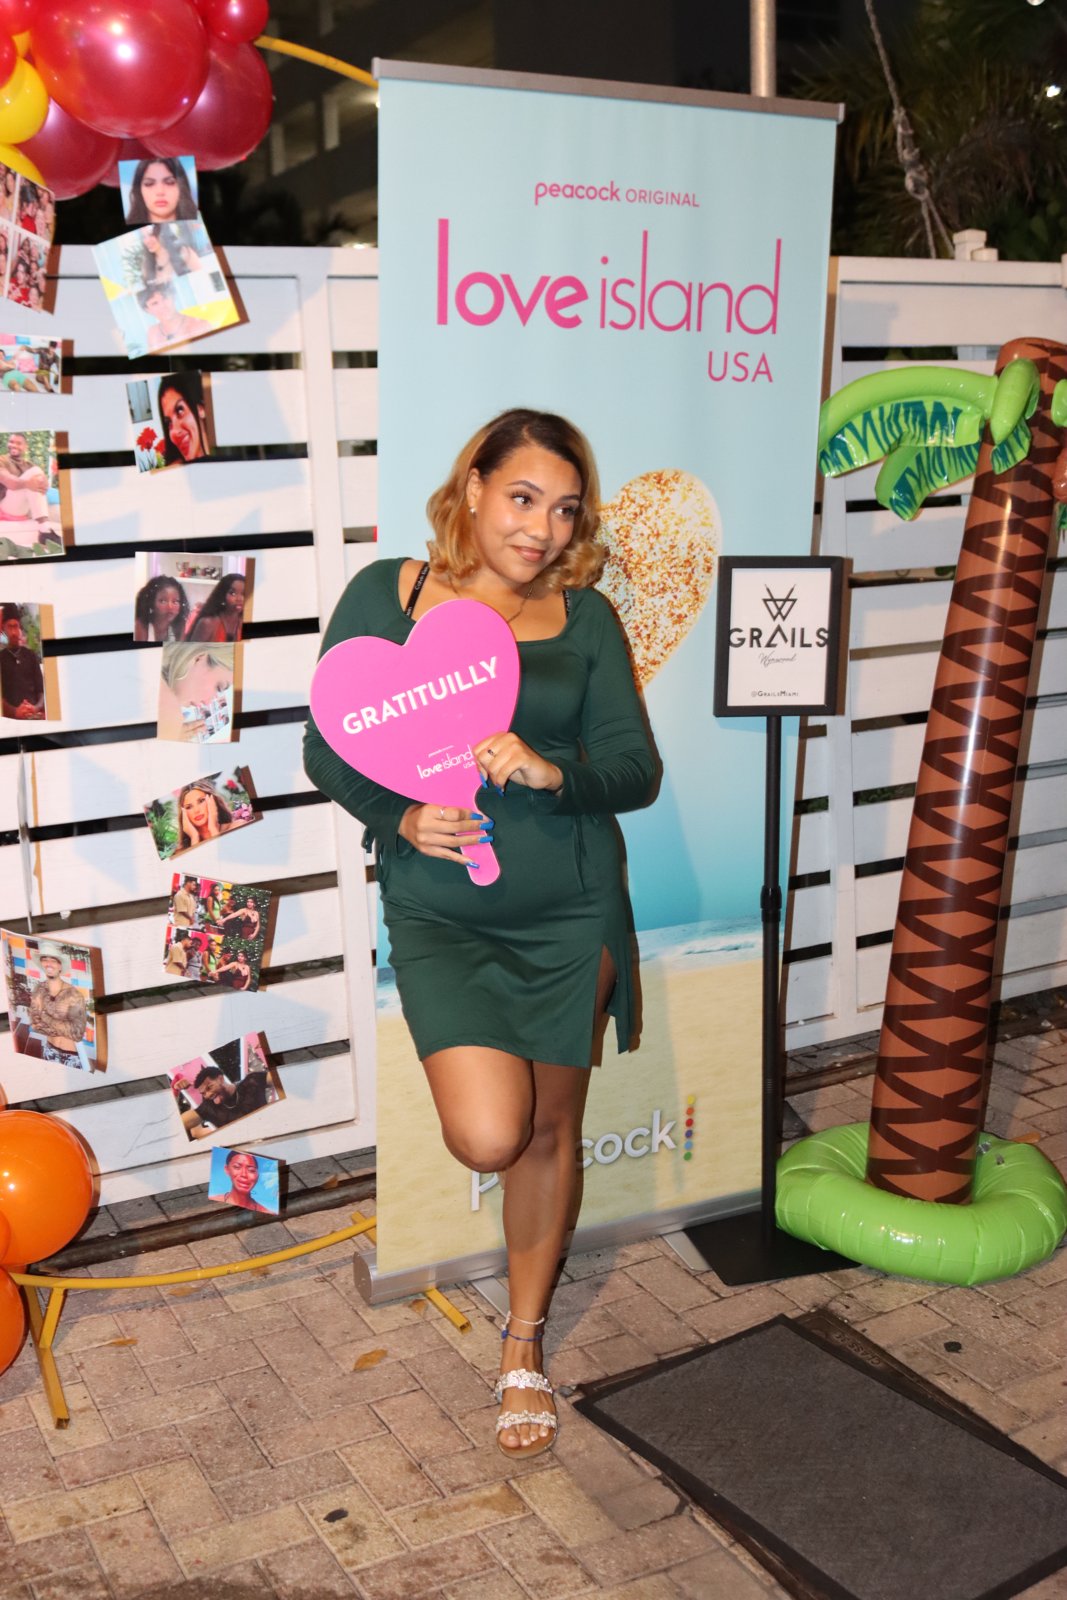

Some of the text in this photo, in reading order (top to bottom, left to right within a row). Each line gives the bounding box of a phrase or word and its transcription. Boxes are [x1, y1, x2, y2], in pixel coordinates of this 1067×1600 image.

[534, 180, 700, 208] peacock ORIGINAL
[436, 218, 782, 335] love island
[707, 350, 774, 383] USA
[729, 624, 829, 648] GRAILS
[342, 656, 497, 734] GRATITUILLY
[416, 764, 443, 779] love
[442, 744, 474, 769] island
[471, 1109, 677, 1212] pcock
